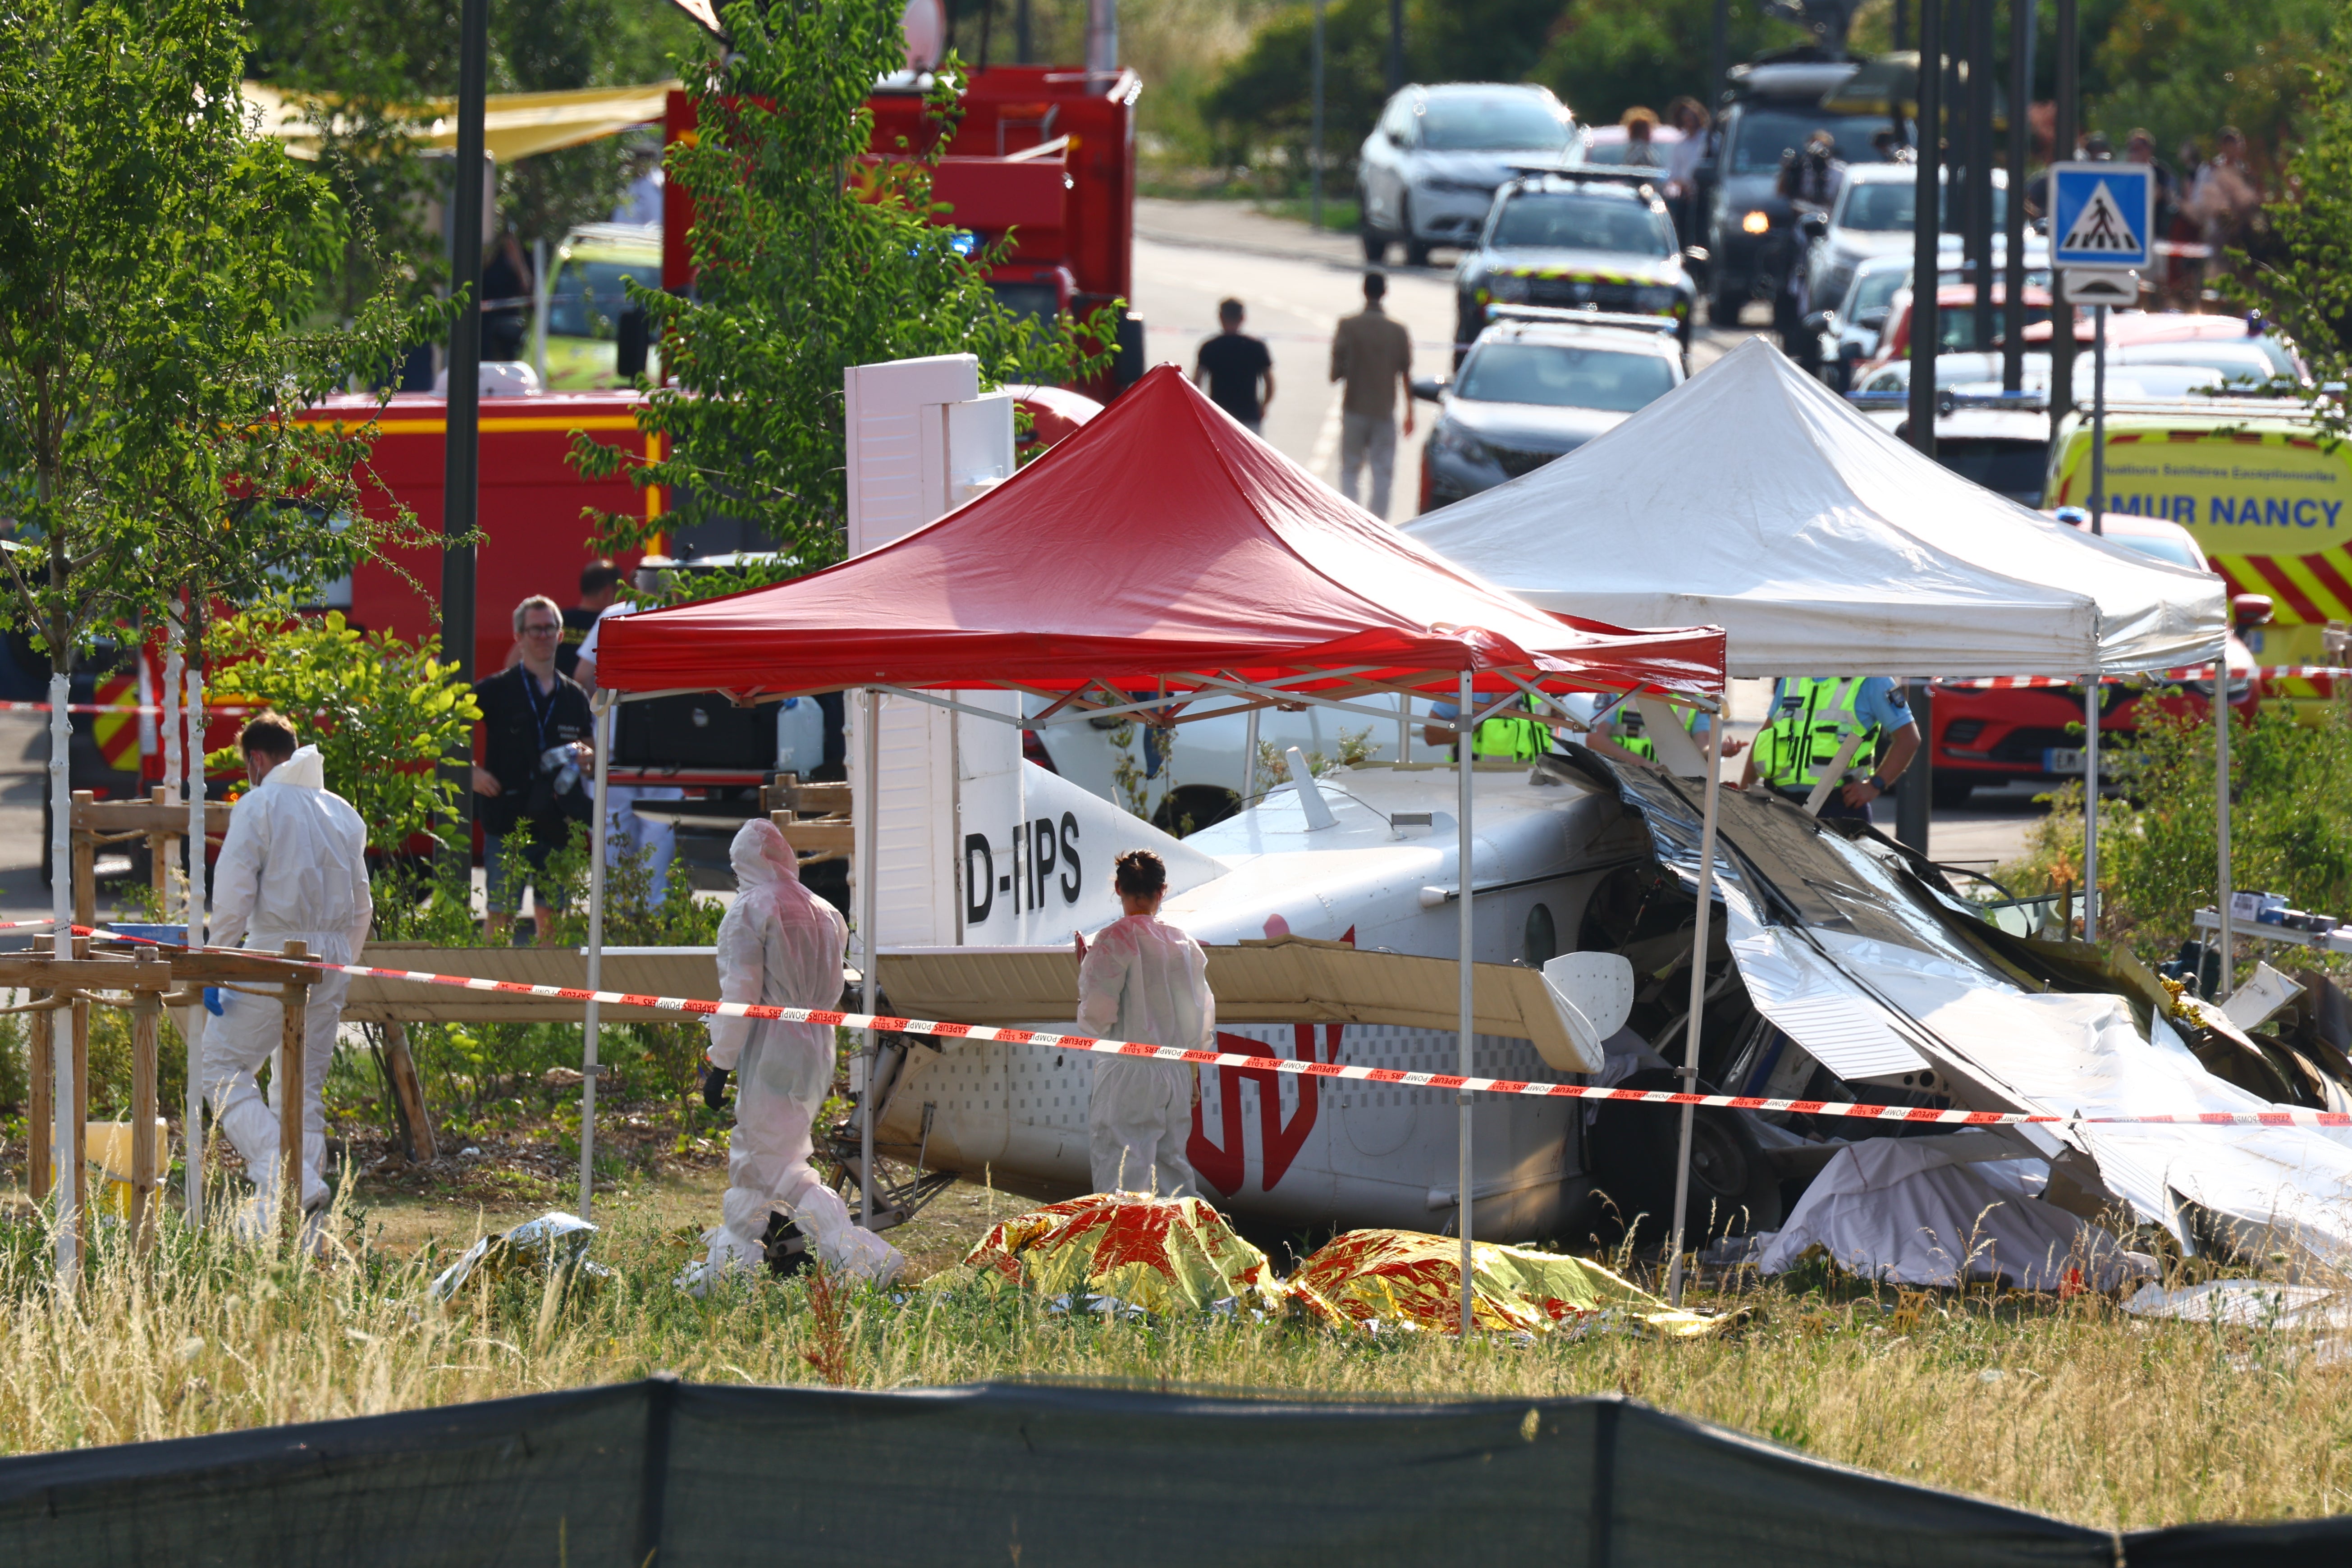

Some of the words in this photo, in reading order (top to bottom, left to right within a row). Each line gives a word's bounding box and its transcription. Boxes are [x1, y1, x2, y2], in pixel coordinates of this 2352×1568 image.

[2210, 496, 2344, 528] NANCY
[966, 811, 1081, 924] D-FIPS
[643, 999, 716, 1013] SAPEURS-POMPIERS
[769, 1009, 842, 1023] SAPEURS-POMPIERS
[894, 1020, 967, 1034] SAPEURS-POMPIERS
[1019, 1033, 1094, 1047] SAPEURS-POMPIERS
[1144, 1046, 1217, 1061] SAPEURS-POMPIERS
[1268, 1060, 1341, 1074] SAPEURS-POMPIERS
[1391, 1073, 1463, 1085] SAPEURS-POMPIERS
[1512, 1084, 1584, 1094] SAPEURS-POMPIERS
[1632, 1092, 1703, 1102] SAPEURS-POMPIERS
[1752, 1099, 1822, 1110] SAPEURS-POMPIERS
[1869, 1107, 1940, 1119] SAPEURS-POMPIERS
